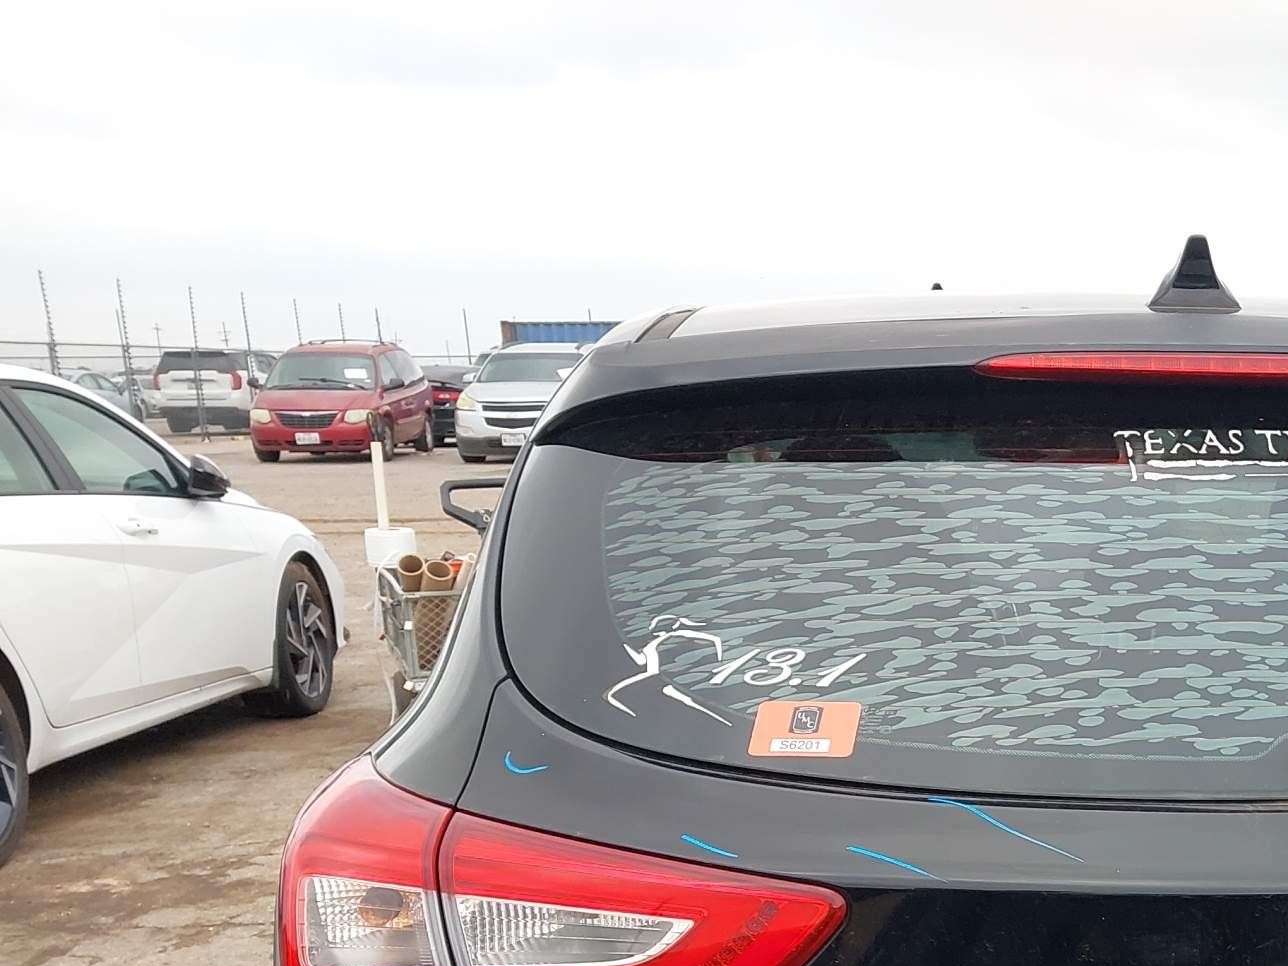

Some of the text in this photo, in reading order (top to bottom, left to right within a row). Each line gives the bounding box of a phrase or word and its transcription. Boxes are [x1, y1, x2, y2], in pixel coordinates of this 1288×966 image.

[1113, 429, 1245, 482] TEXAS
[709, 648, 867, 688] 13.1
[779, 740, 820, 750] S6201
